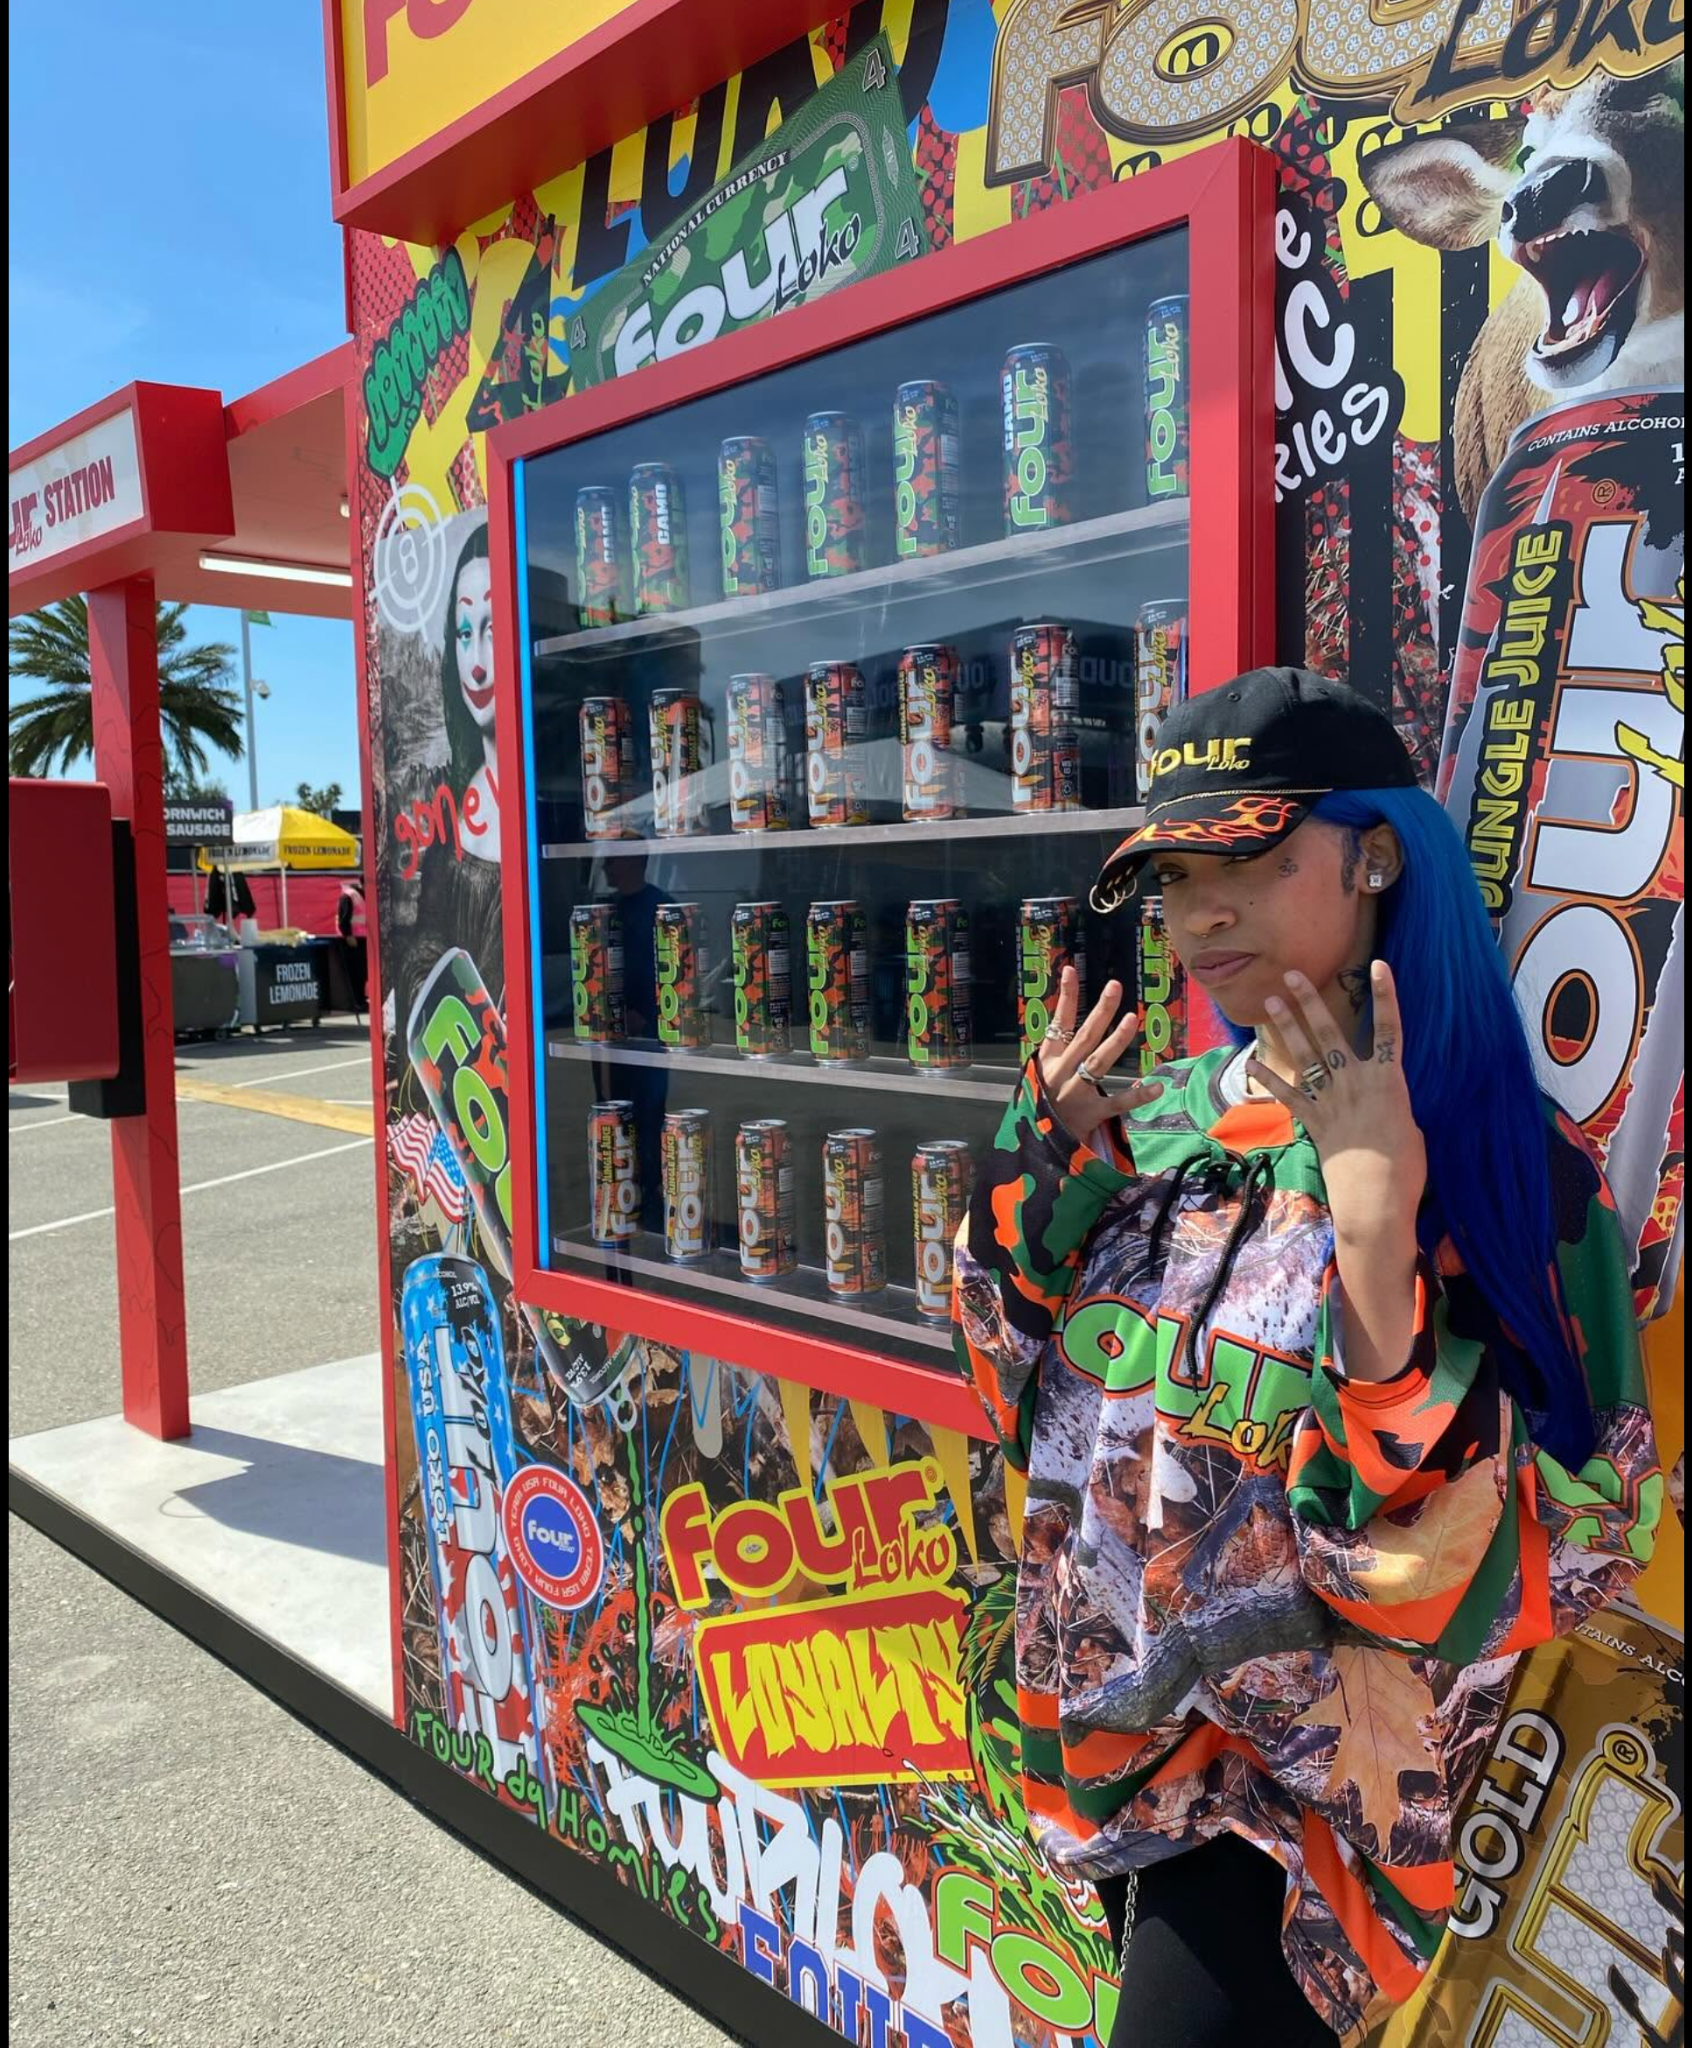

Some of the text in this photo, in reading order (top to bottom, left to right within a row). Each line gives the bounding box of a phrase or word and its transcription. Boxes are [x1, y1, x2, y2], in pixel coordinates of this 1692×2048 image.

[641, 150, 790, 288] NATIONAL CURRENCY
[615, 165, 861, 378] four Loko
[903, 406, 918, 457] Loko
[1003, 373, 1014, 451] CAMO
[1146, 327, 1177, 496] four
[1163, 322, 1181, 383] Loko
[1528, 423, 1601, 452] CONTAINS
[815, 433, 829, 484] Loko
[1010, 369, 1047, 528] four
[1033, 367, 1050, 423] Loko
[44, 455, 115, 528] STATION
[655, 483, 670, 545] CAMO
[1486, 529, 1563, 690] JUICE
[1020, 648, 1034, 703] Loko
[1150, 626, 1168, 684] Loko
[904, 666, 936, 809] four Loko
[1206, 755, 1250, 771] Loko
[166, 823, 231, 836] SAUSAGE
[276, 963, 311, 983] FROZEN
[1035, 922, 1053, 976] Loko
[269, 982, 319, 1005] LEMONADE
[602, 1125, 612, 1184] JUNGLE JUICE
[610, 1126, 637, 1235] four
[667, 1133, 677, 1197] JUNGLE JUICE
[673, 1136, 703, 1252] four
[916, 1171, 948, 1310] four Loko
[451, 1281, 478, 1297] 13.9%
[416, 1330, 450, 1547] LOKO USA
[527, 1519, 574, 1547] four
[665, 1470, 950, 1604] four Loko
[415, 1712, 497, 1792] FOUR
[1447, 1707, 1566, 1940] GOLD
